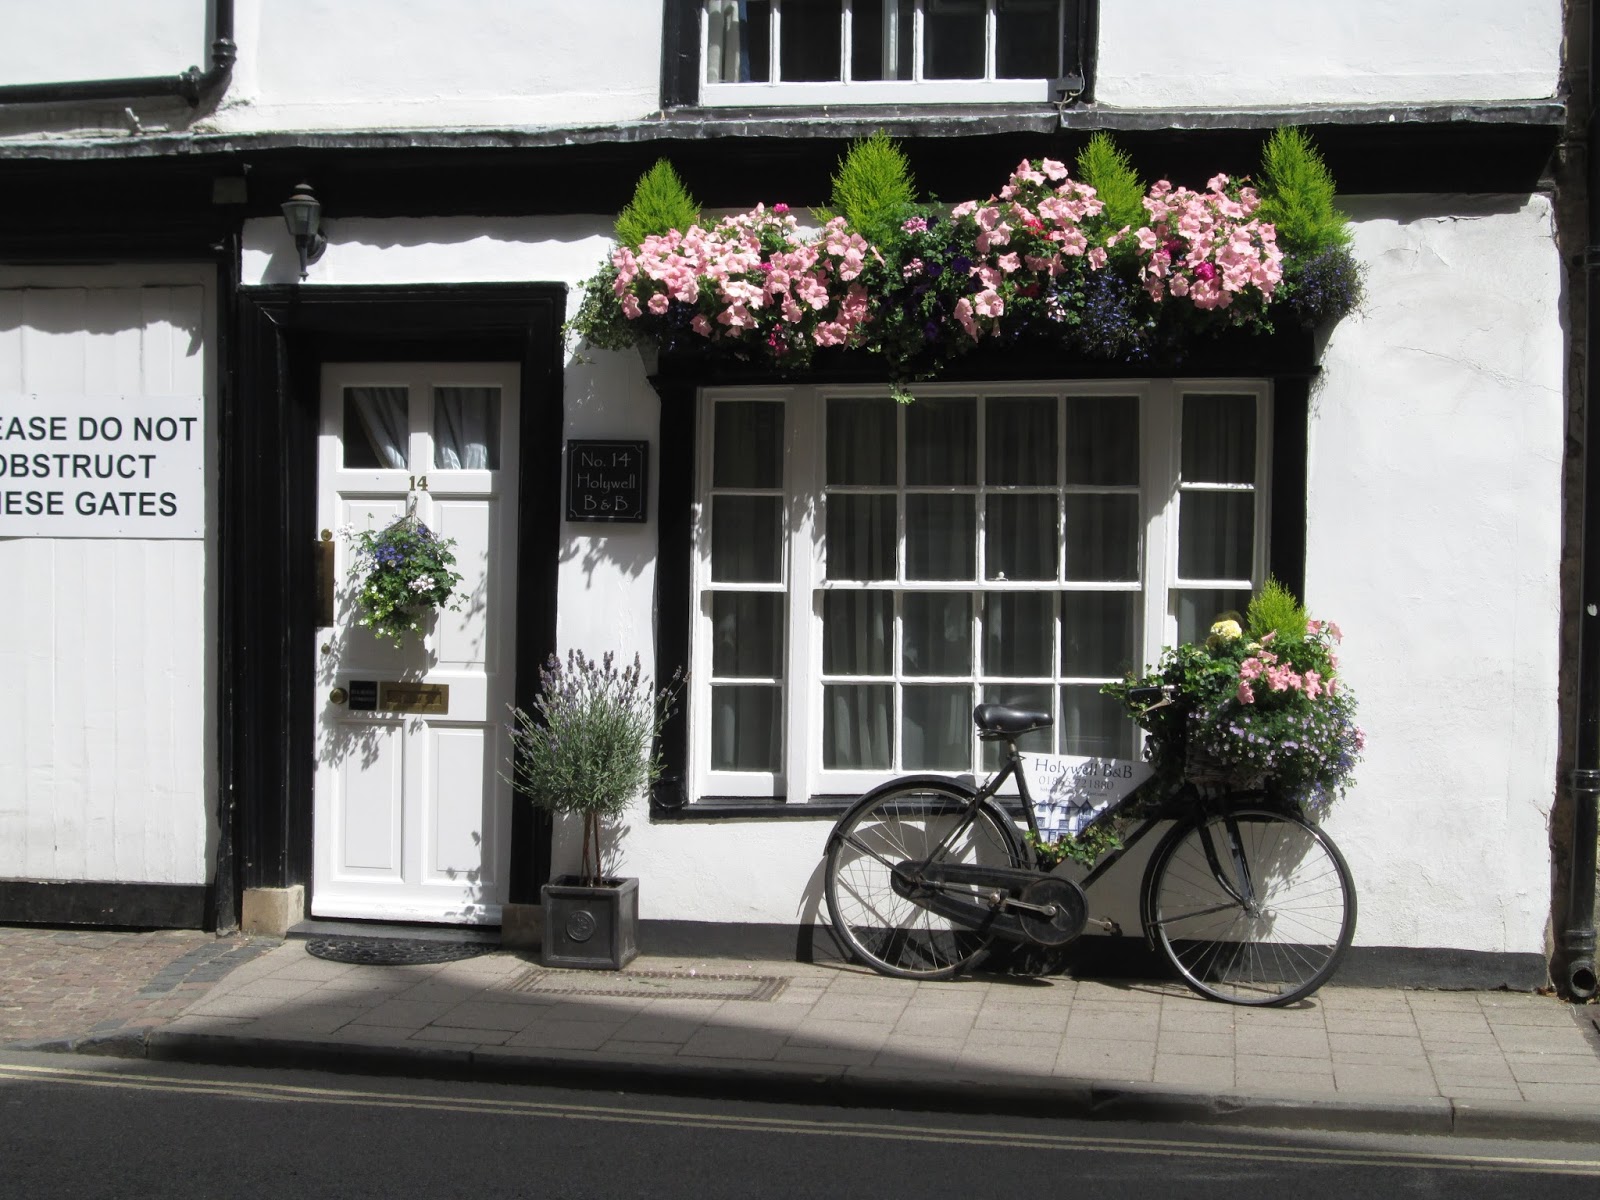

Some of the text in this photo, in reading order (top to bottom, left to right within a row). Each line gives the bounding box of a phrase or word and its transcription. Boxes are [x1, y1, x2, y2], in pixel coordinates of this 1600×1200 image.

[0, 416, 198, 441] ASE DO NOT
[581, 452, 632, 467] No. 14
[409, 475, 428, 491] 14
[577, 473, 636, 494] Holywell
[0, 491, 178, 517] ESE GATES
[1035, 758, 1133, 779] Holywell B&B
